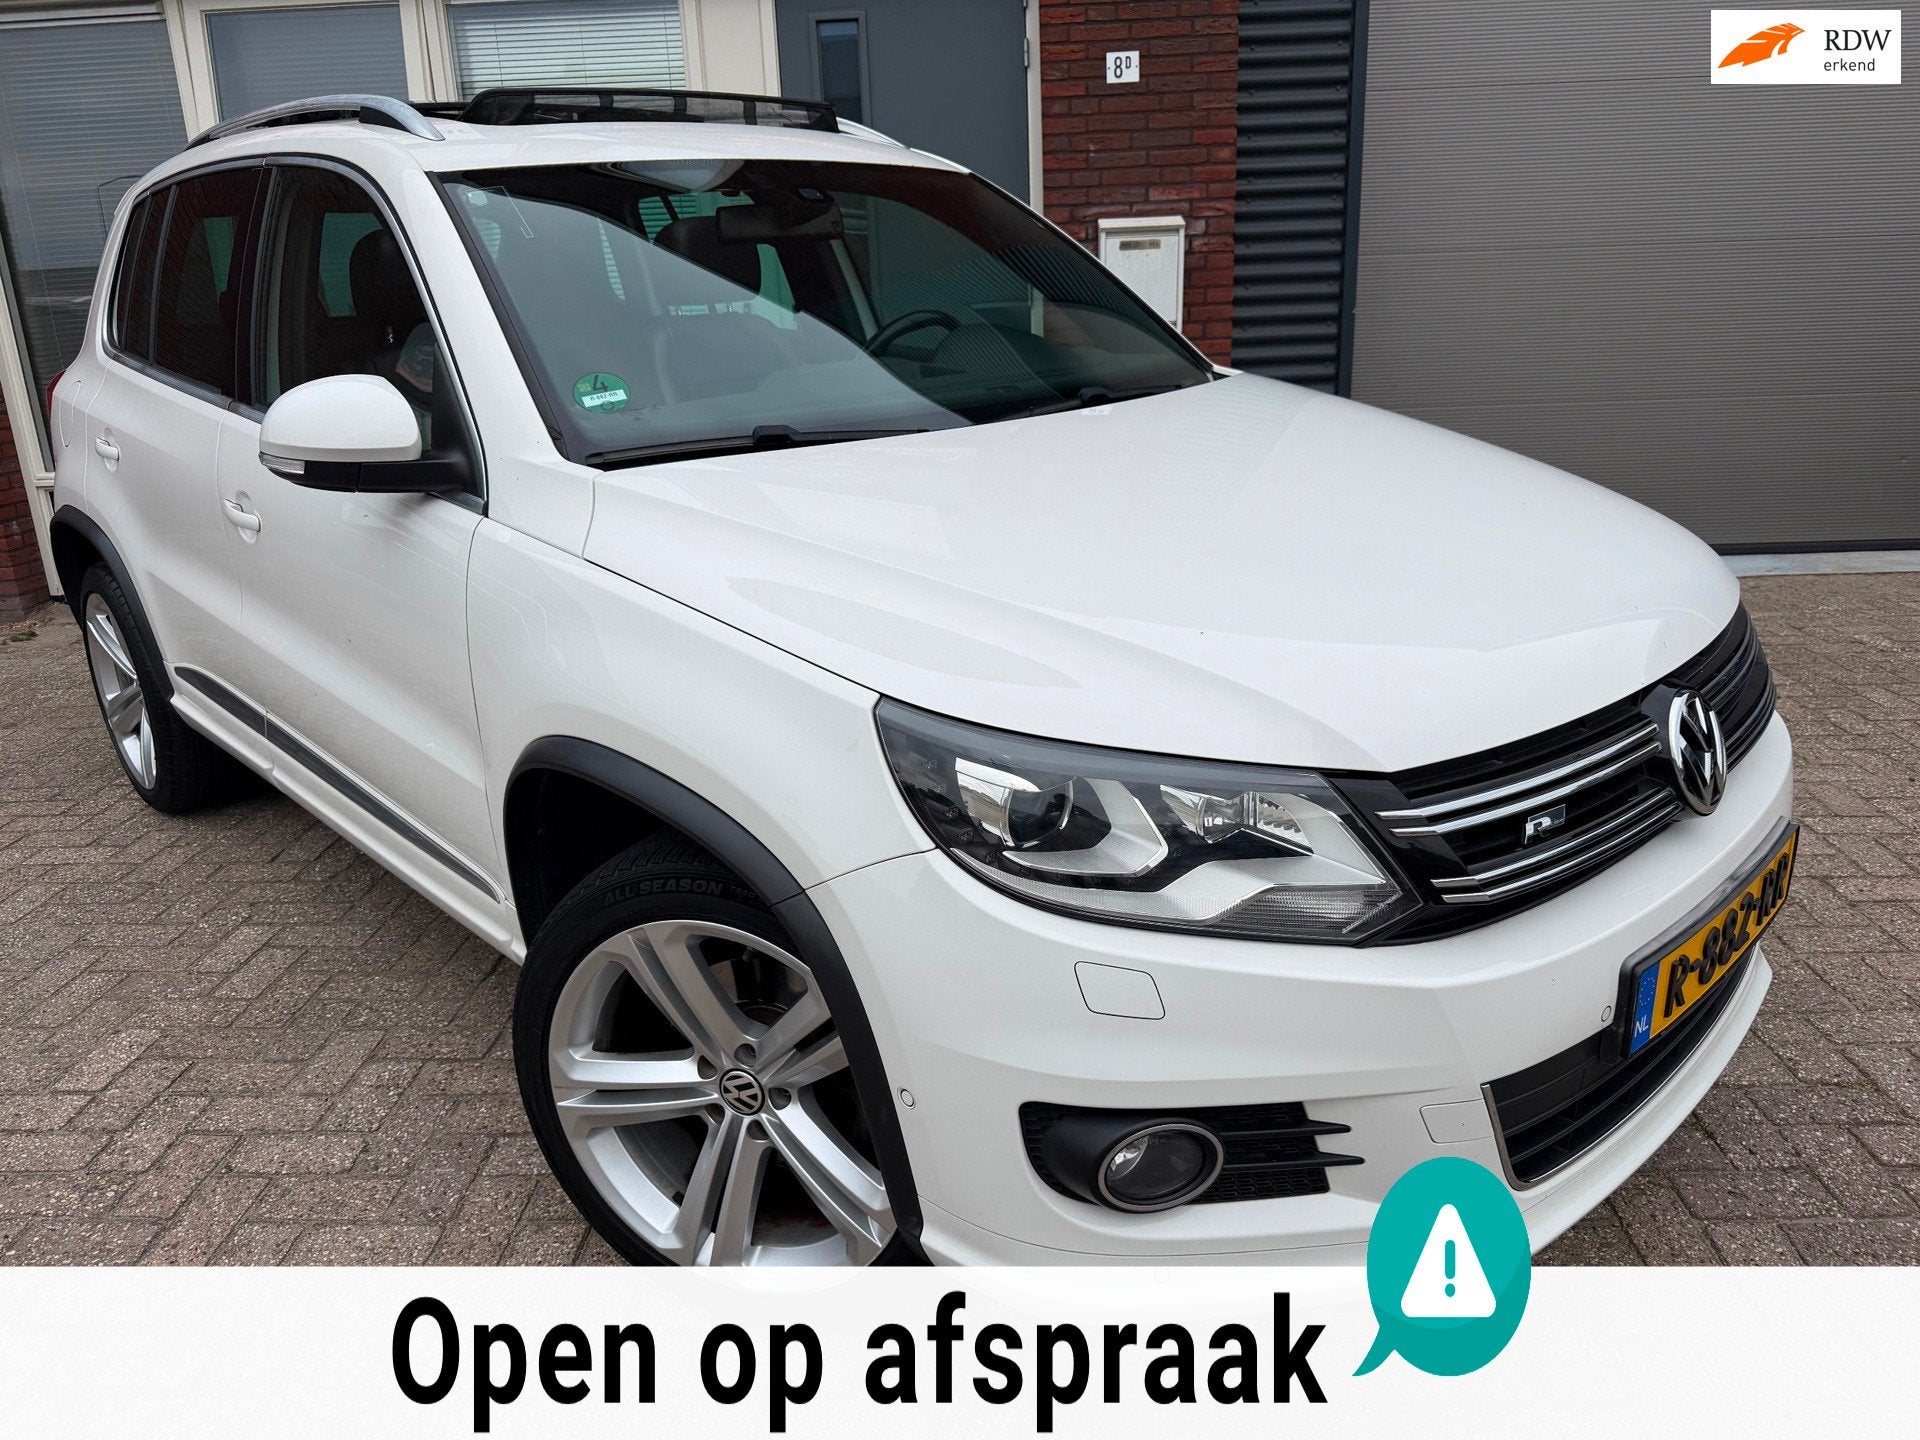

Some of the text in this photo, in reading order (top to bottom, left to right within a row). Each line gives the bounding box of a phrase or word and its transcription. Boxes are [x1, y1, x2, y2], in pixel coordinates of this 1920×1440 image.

[593, 375, 609, 392] 4
[604, 886, 635, 906] ALL
[639, 878, 723, 896] SEASON
[1663, 852, 1789, 1018] R-882-RR
[1634, 1016, 1649, 1038] NL
